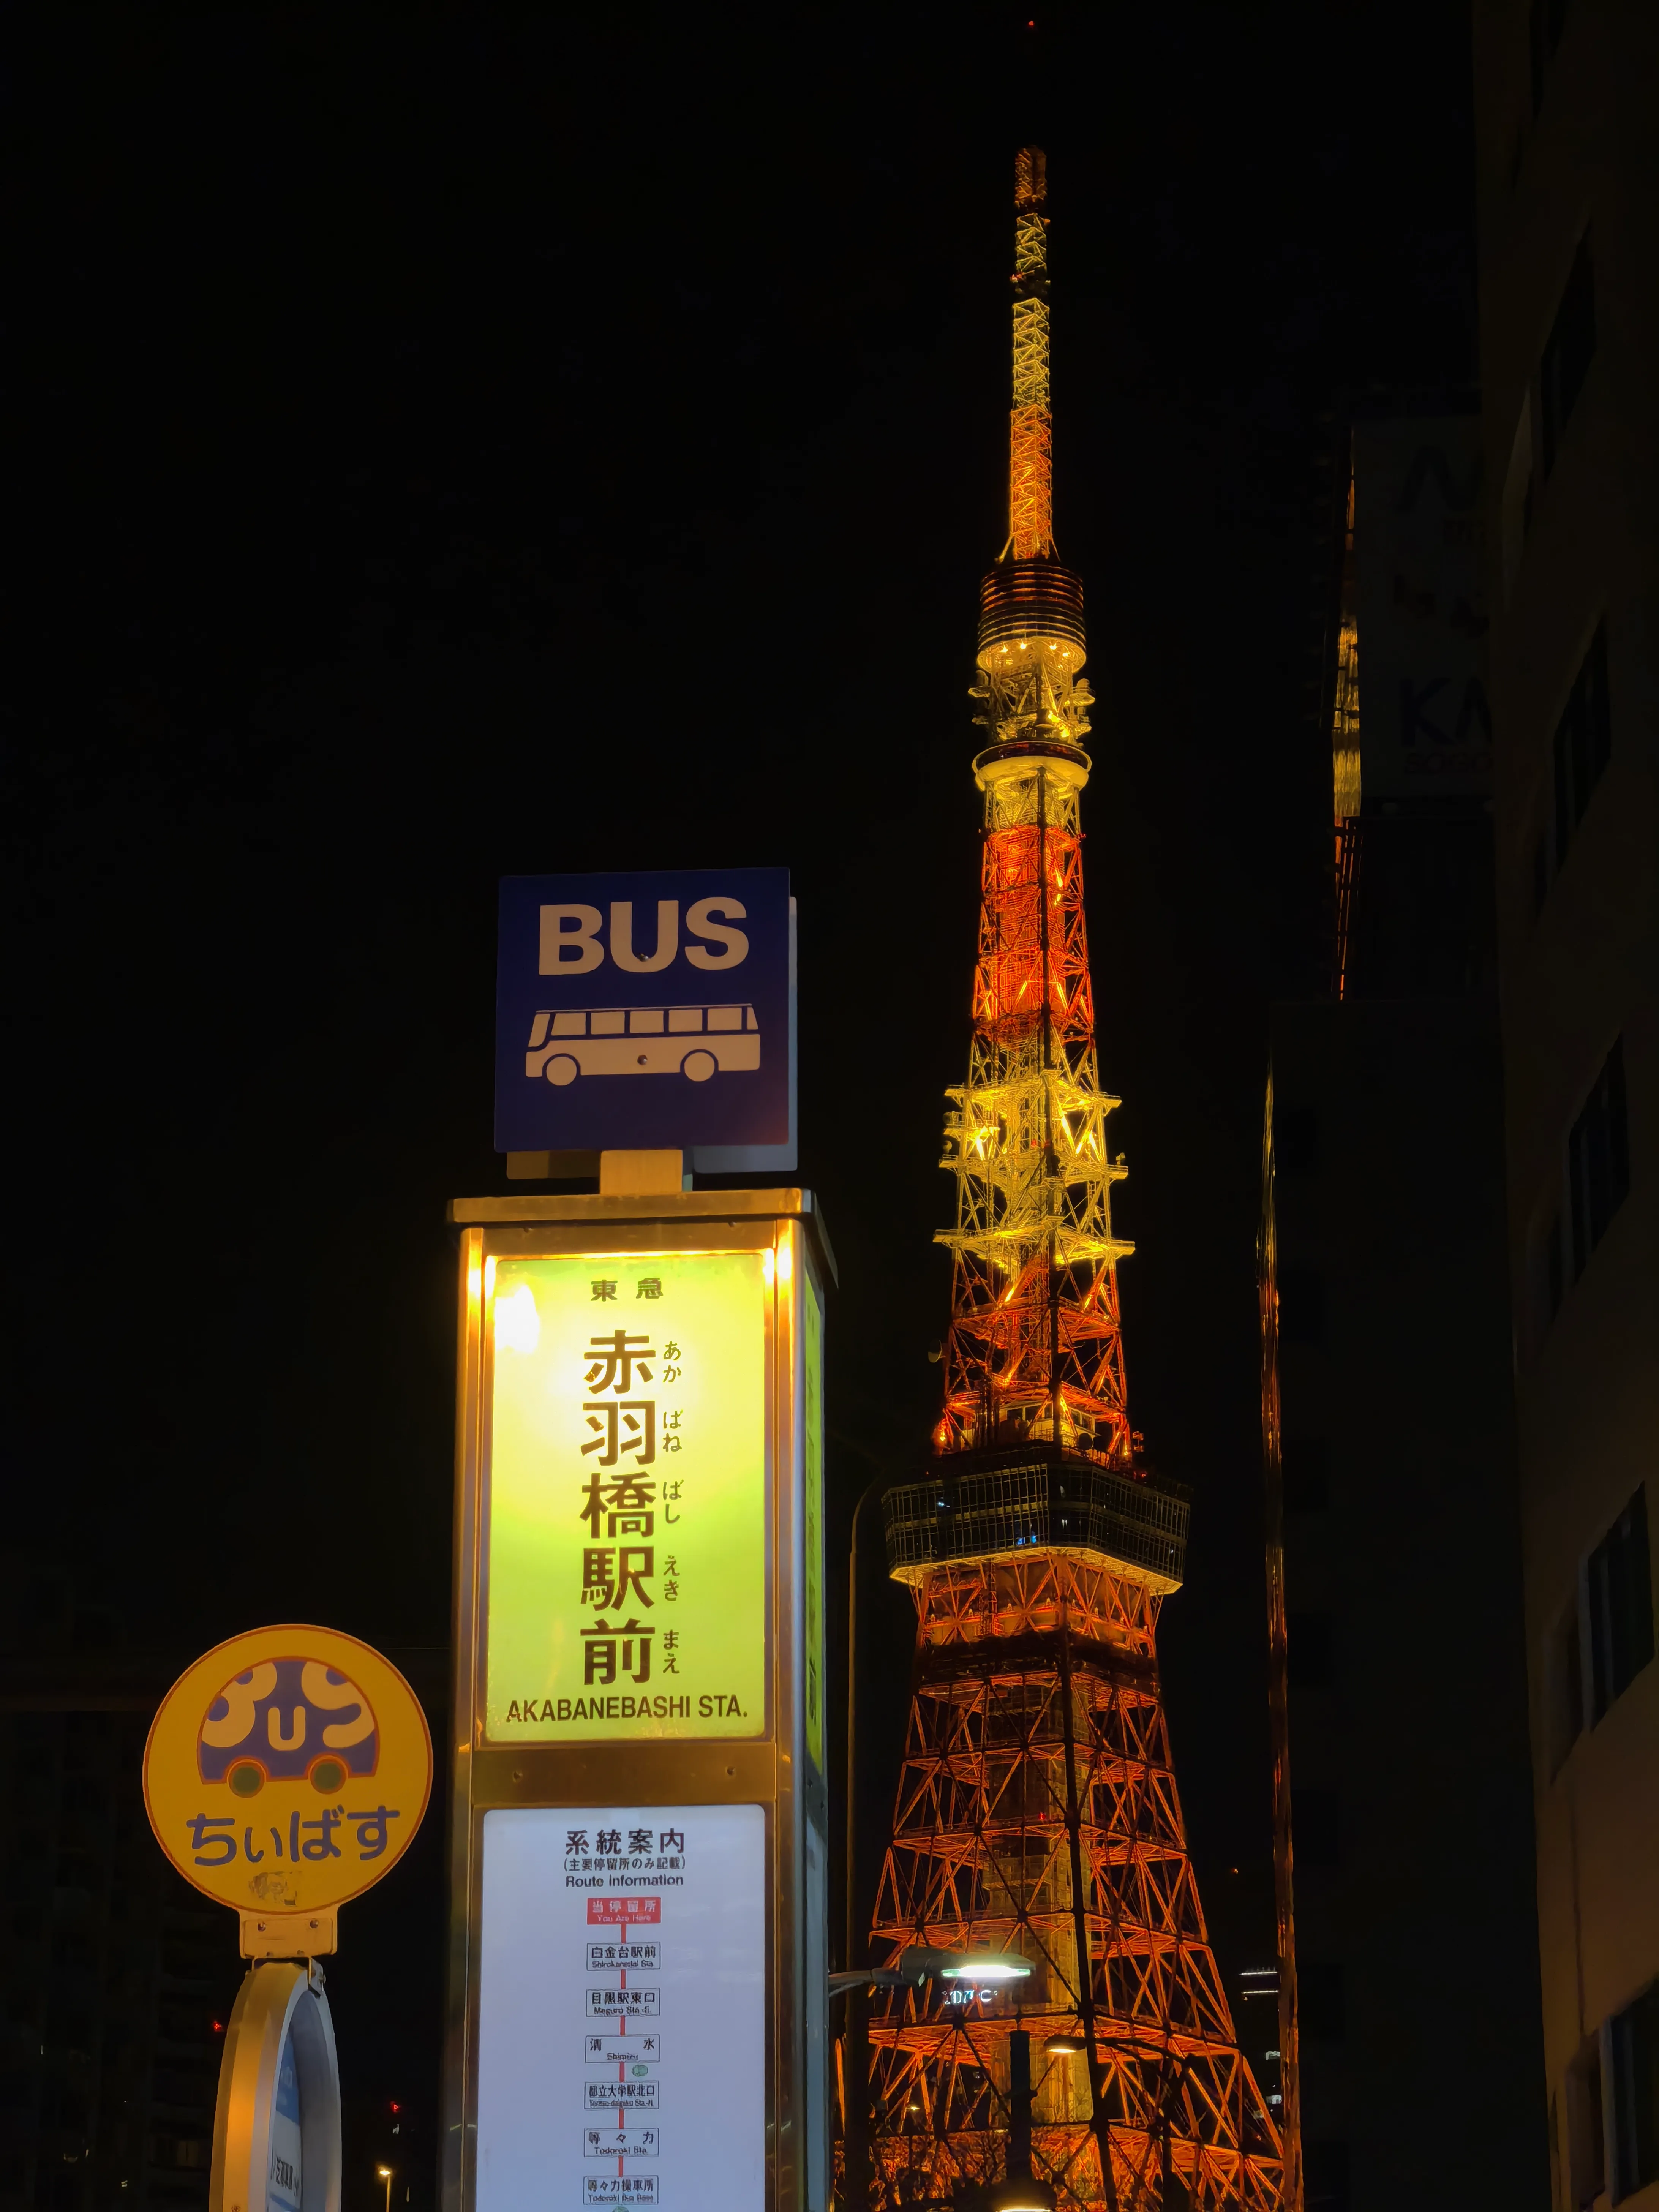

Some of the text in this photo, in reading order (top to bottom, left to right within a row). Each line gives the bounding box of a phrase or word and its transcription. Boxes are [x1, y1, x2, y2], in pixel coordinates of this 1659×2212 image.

[539, 897, 749, 975] BUS
[591, 1277, 663, 1302] 東急
[579, 1330, 656, 1685] 赤羽橋駅前
[506, 1695, 748, 1723] AKABANEBASHI STA.
[566, 1828, 684, 1855] 系統案内
[566, 1874, 684, 1887] Route Information
[591, 1945, 656, 1958] 白金台駅前
[592, 1992, 655, 2004] 目黒駅東口
[589, 2084, 654, 2097] 都立大学駅北口
